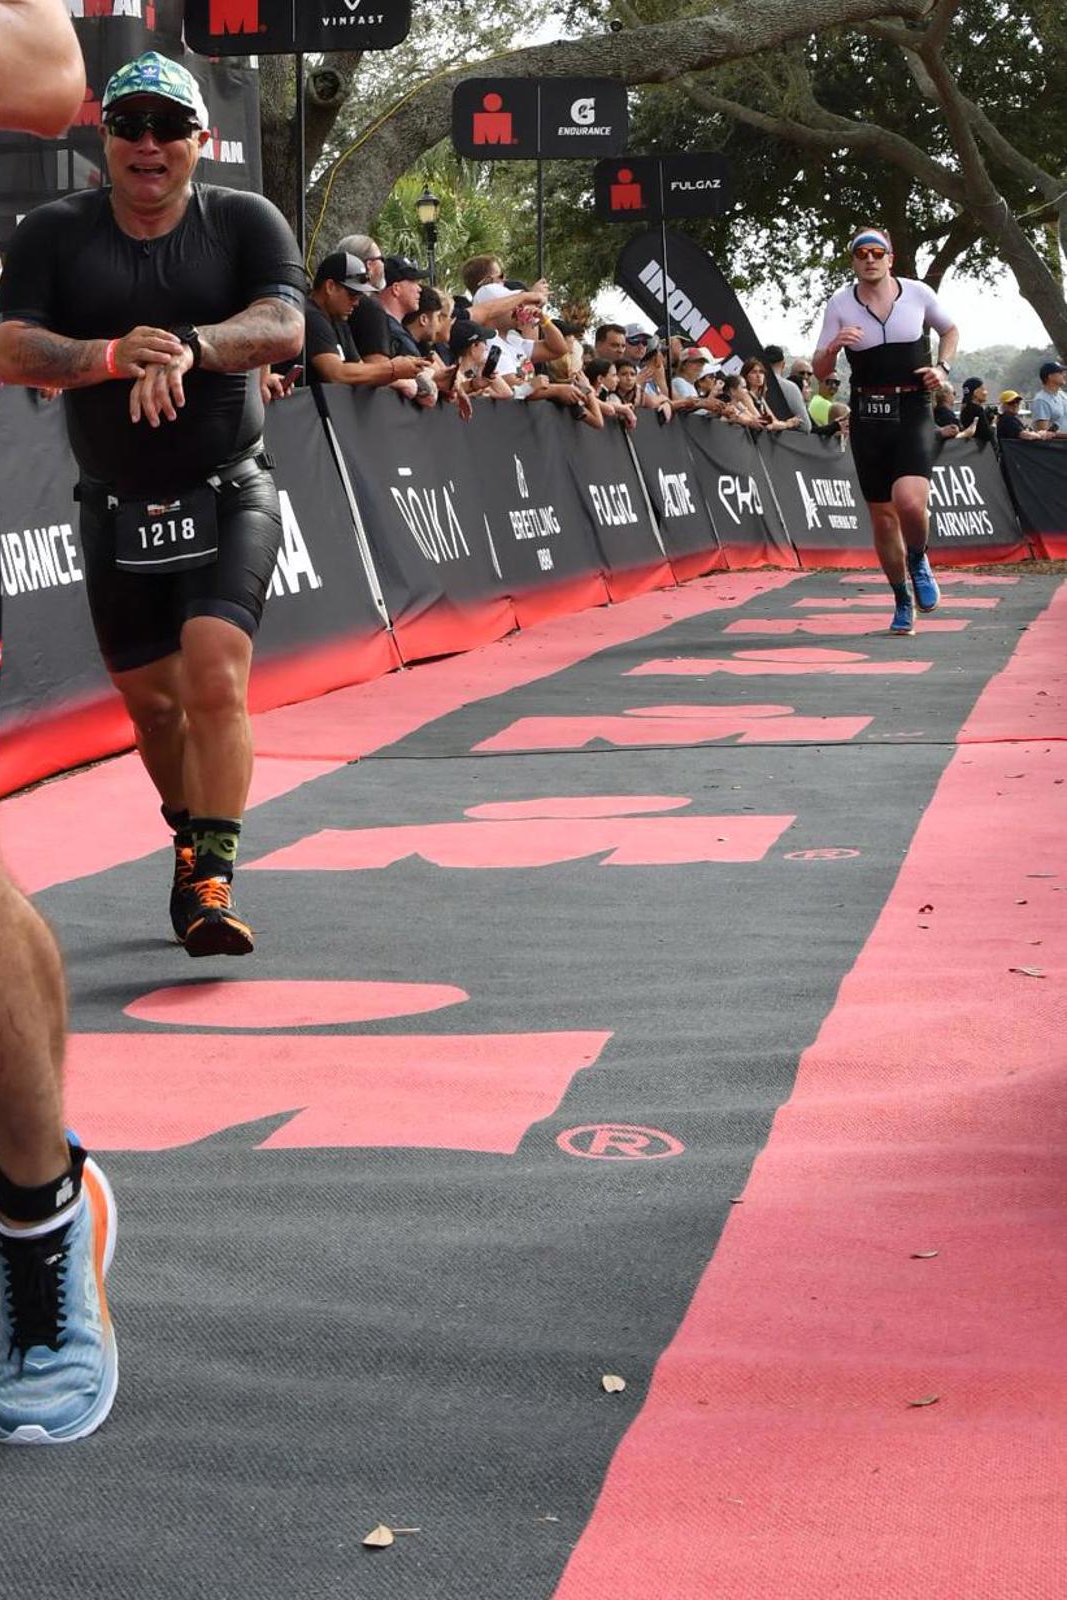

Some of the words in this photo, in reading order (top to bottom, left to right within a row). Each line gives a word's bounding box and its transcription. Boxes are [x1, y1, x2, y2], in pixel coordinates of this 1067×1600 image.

[322, 14, 384, 27] VINFAST
[557, 125, 612, 137] ENDURANCE
[671, 179, 722, 192] FULGAZ
[928, 466, 985, 506] ATAR
[138, 518, 195, 549] 1218
[509, 505, 562, 540] BREITLING
[936, 510, 994, 537] AIRWAYS
[0, 523, 84, 597] URANCE
